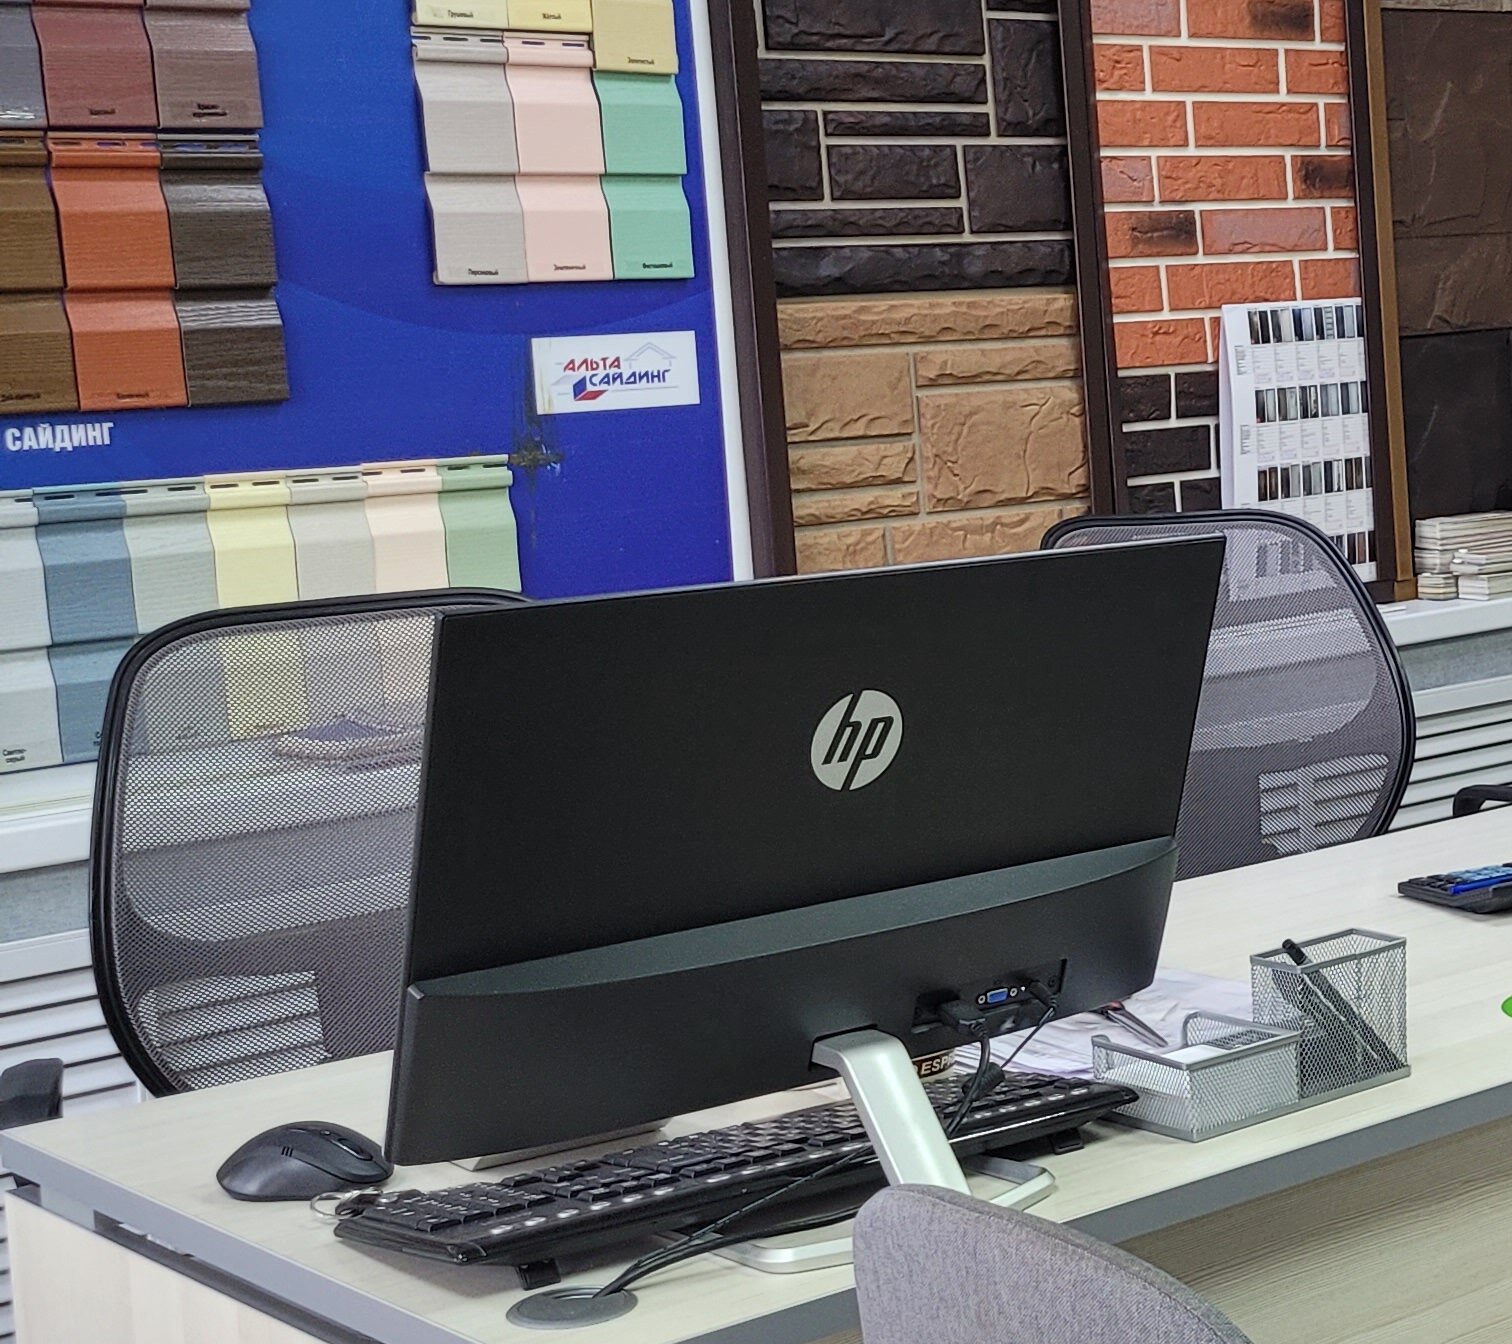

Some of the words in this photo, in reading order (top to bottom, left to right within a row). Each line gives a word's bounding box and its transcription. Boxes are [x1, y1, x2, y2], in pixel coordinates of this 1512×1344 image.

[563, 356, 621, 372] АЛЬТА
[589, 369, 671, 386] САЙДИНГ
[5, 422, 114, 452] САЙДИНГ
[816, 690, 899, 791] hp
